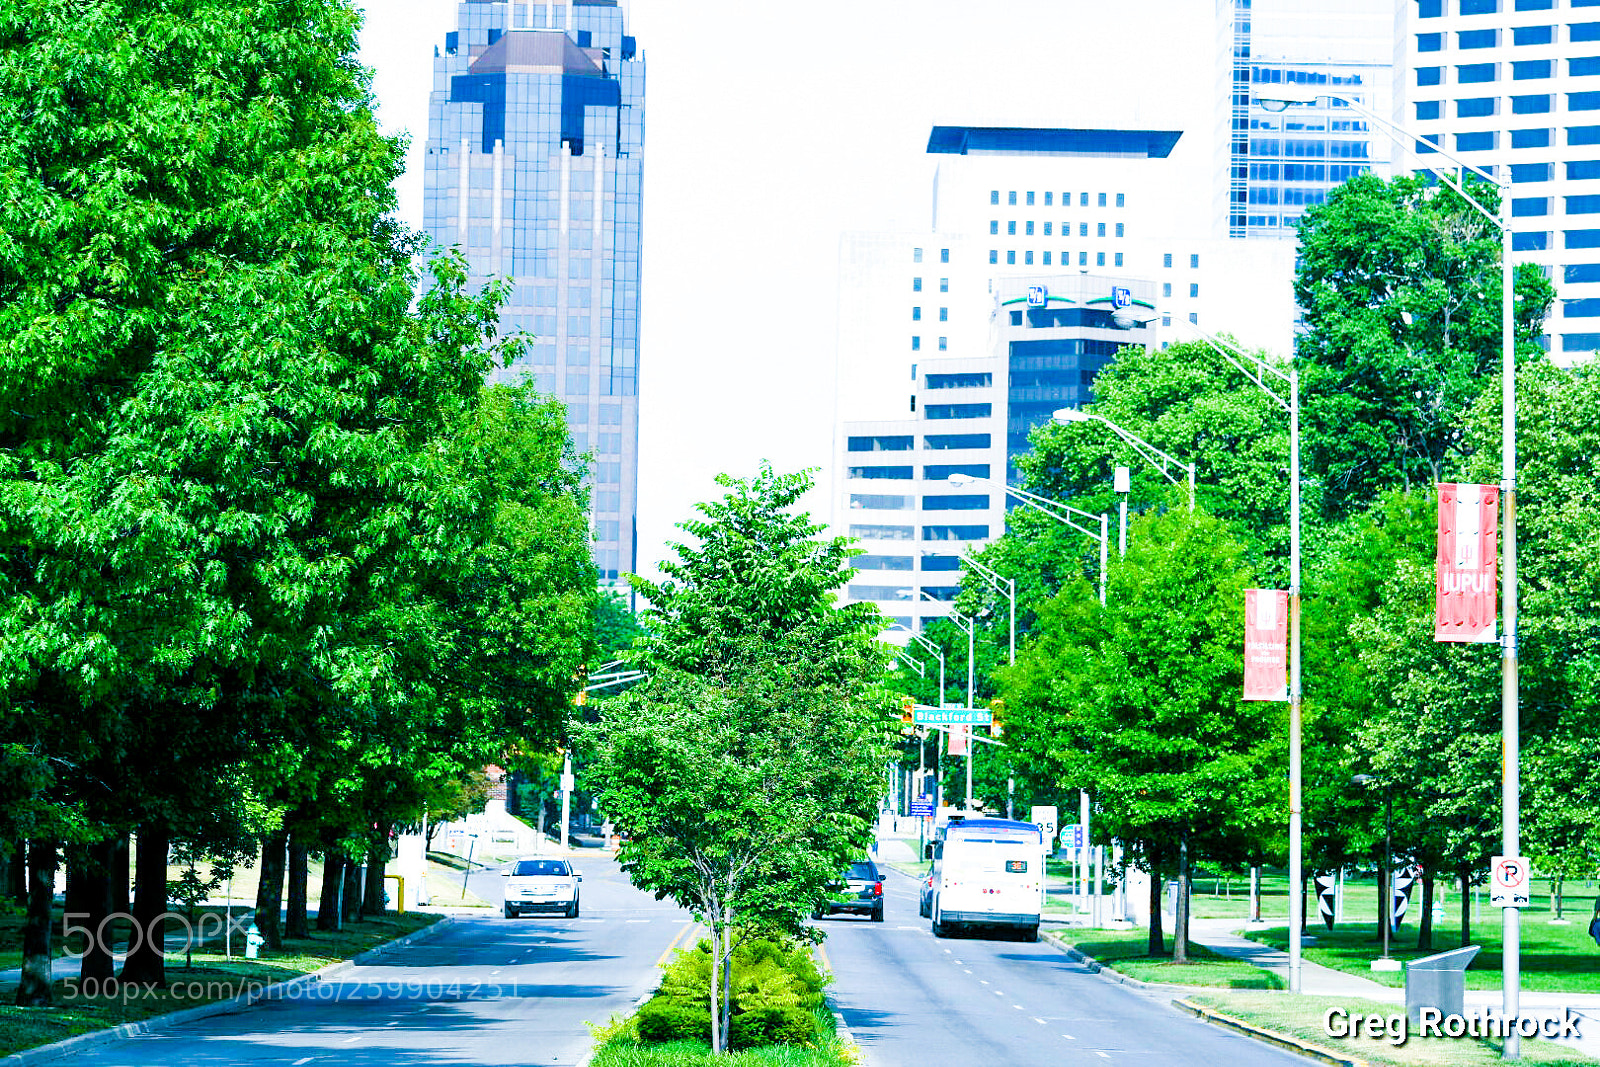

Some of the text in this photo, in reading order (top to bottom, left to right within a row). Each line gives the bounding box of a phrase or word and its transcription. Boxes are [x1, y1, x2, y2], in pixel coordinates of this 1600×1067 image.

[1443, 572, 1489, 592] IUPUI
[916, 711, 990, 721] Blackford St
